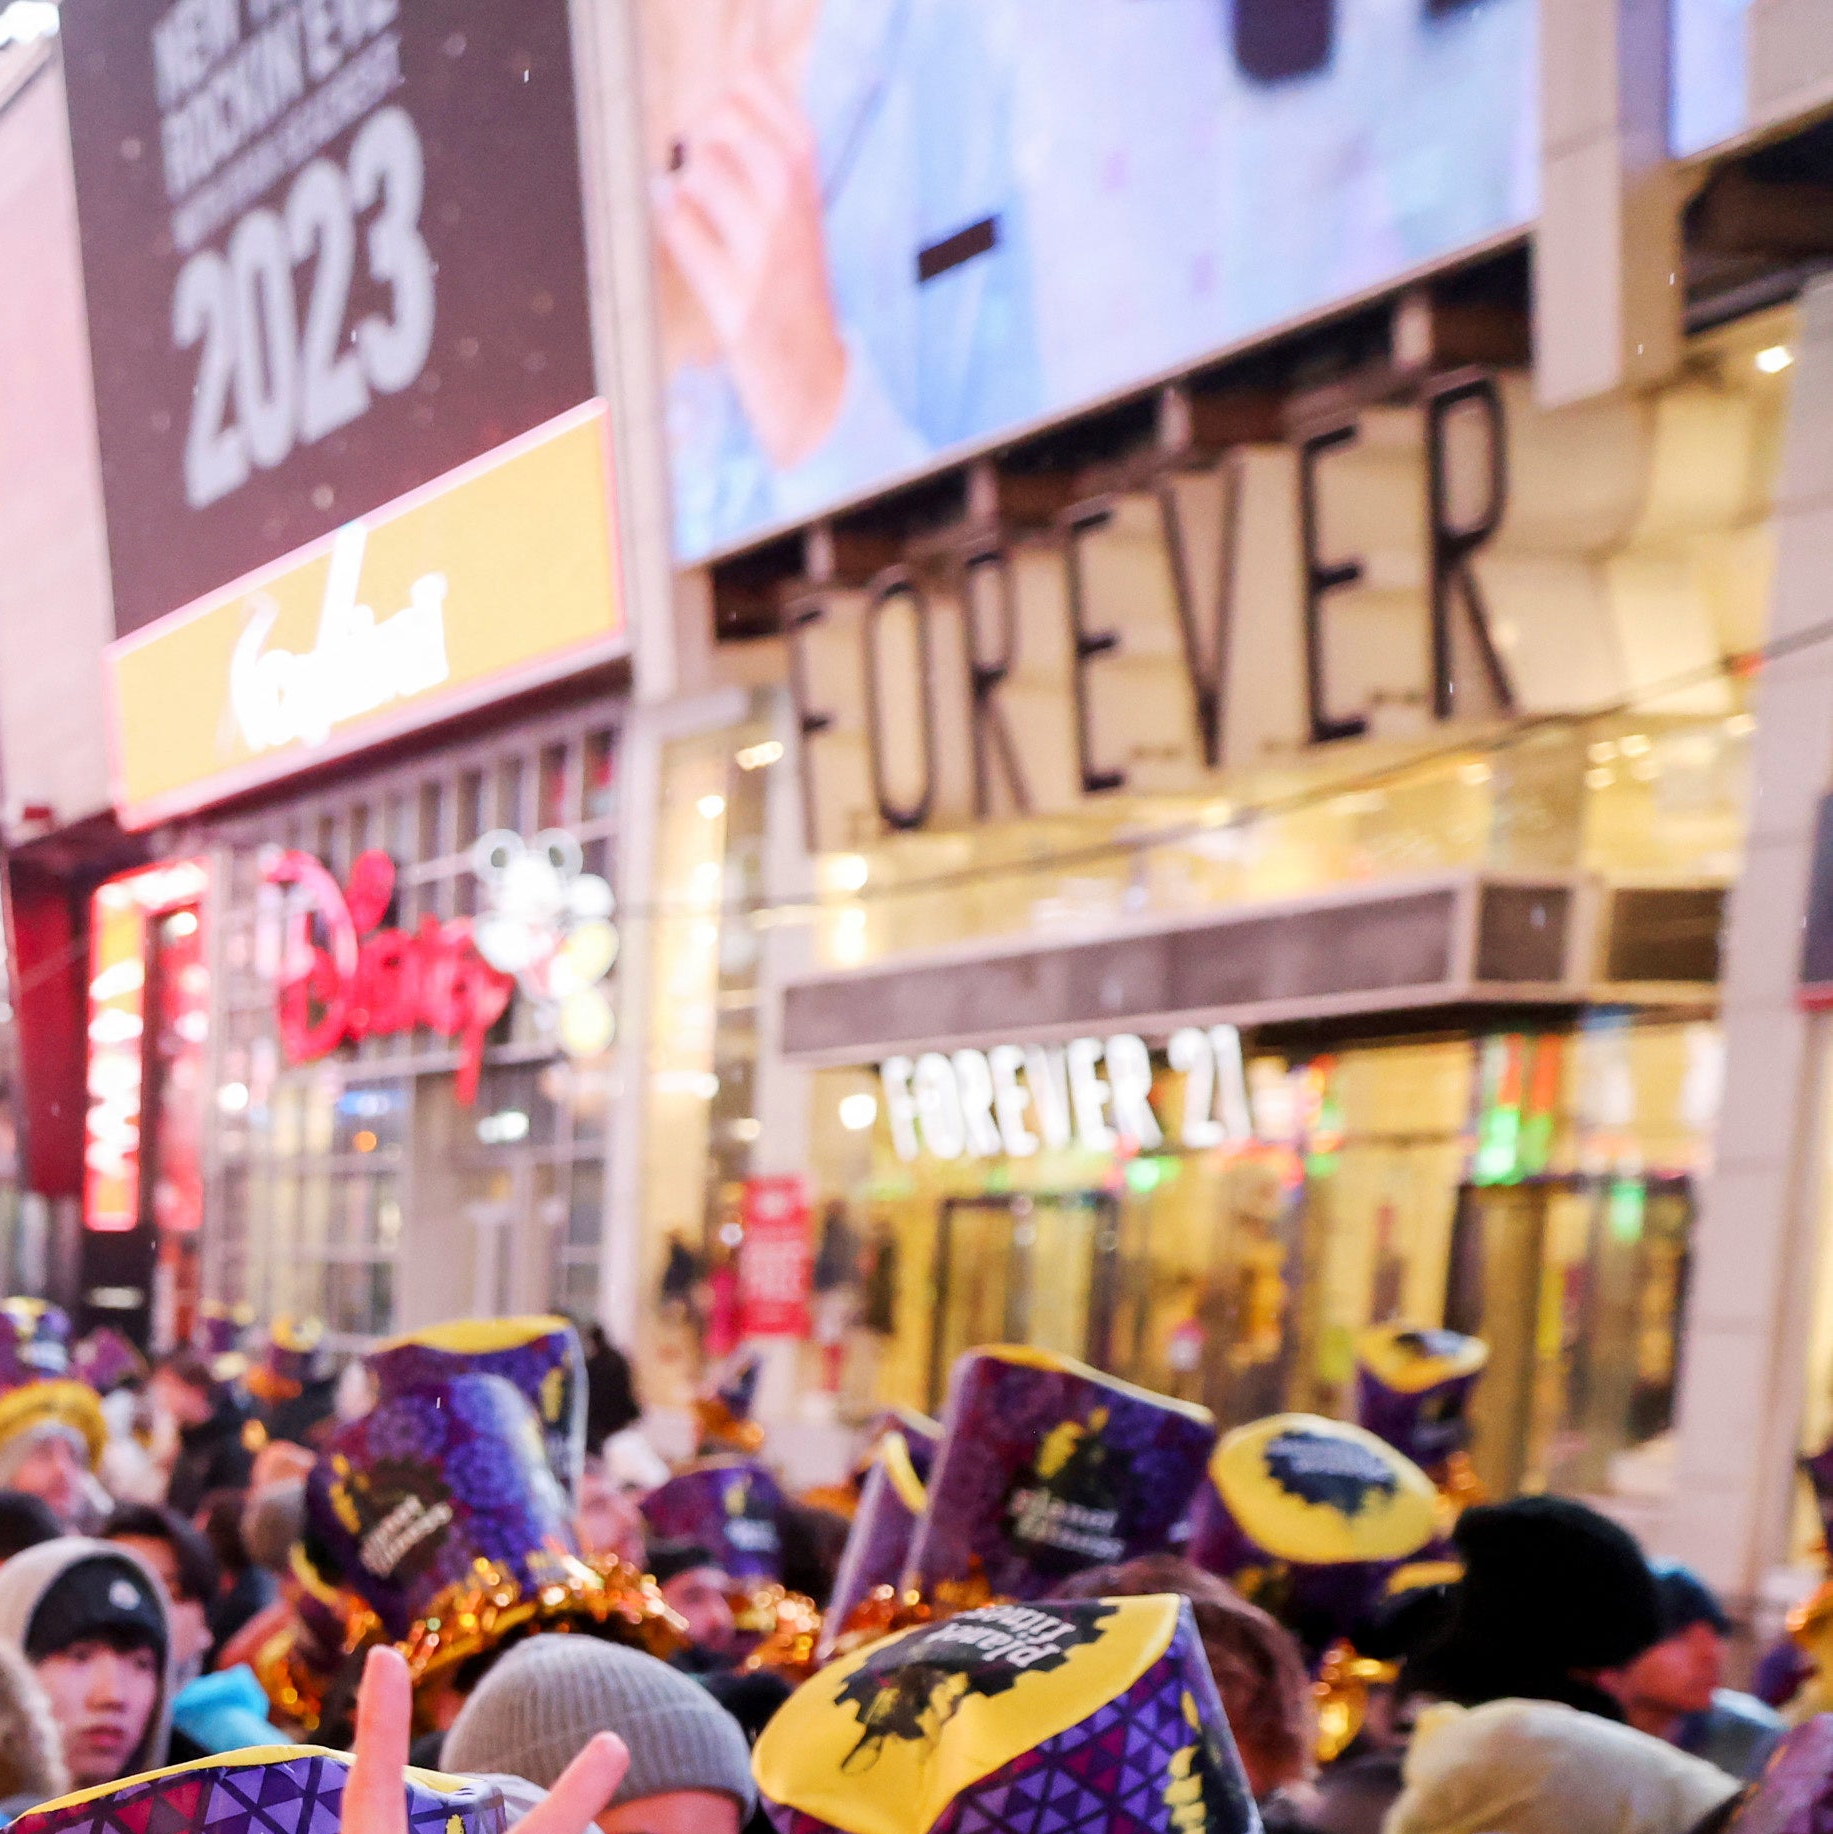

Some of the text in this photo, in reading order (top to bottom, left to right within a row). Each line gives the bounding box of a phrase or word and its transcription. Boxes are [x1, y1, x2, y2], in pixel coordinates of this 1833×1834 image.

[171, 104, 437, 510] 2023
[789, 366, 1517, 854] FOREVER
[880, 1023, 1253, 1162] FOREVER 21
